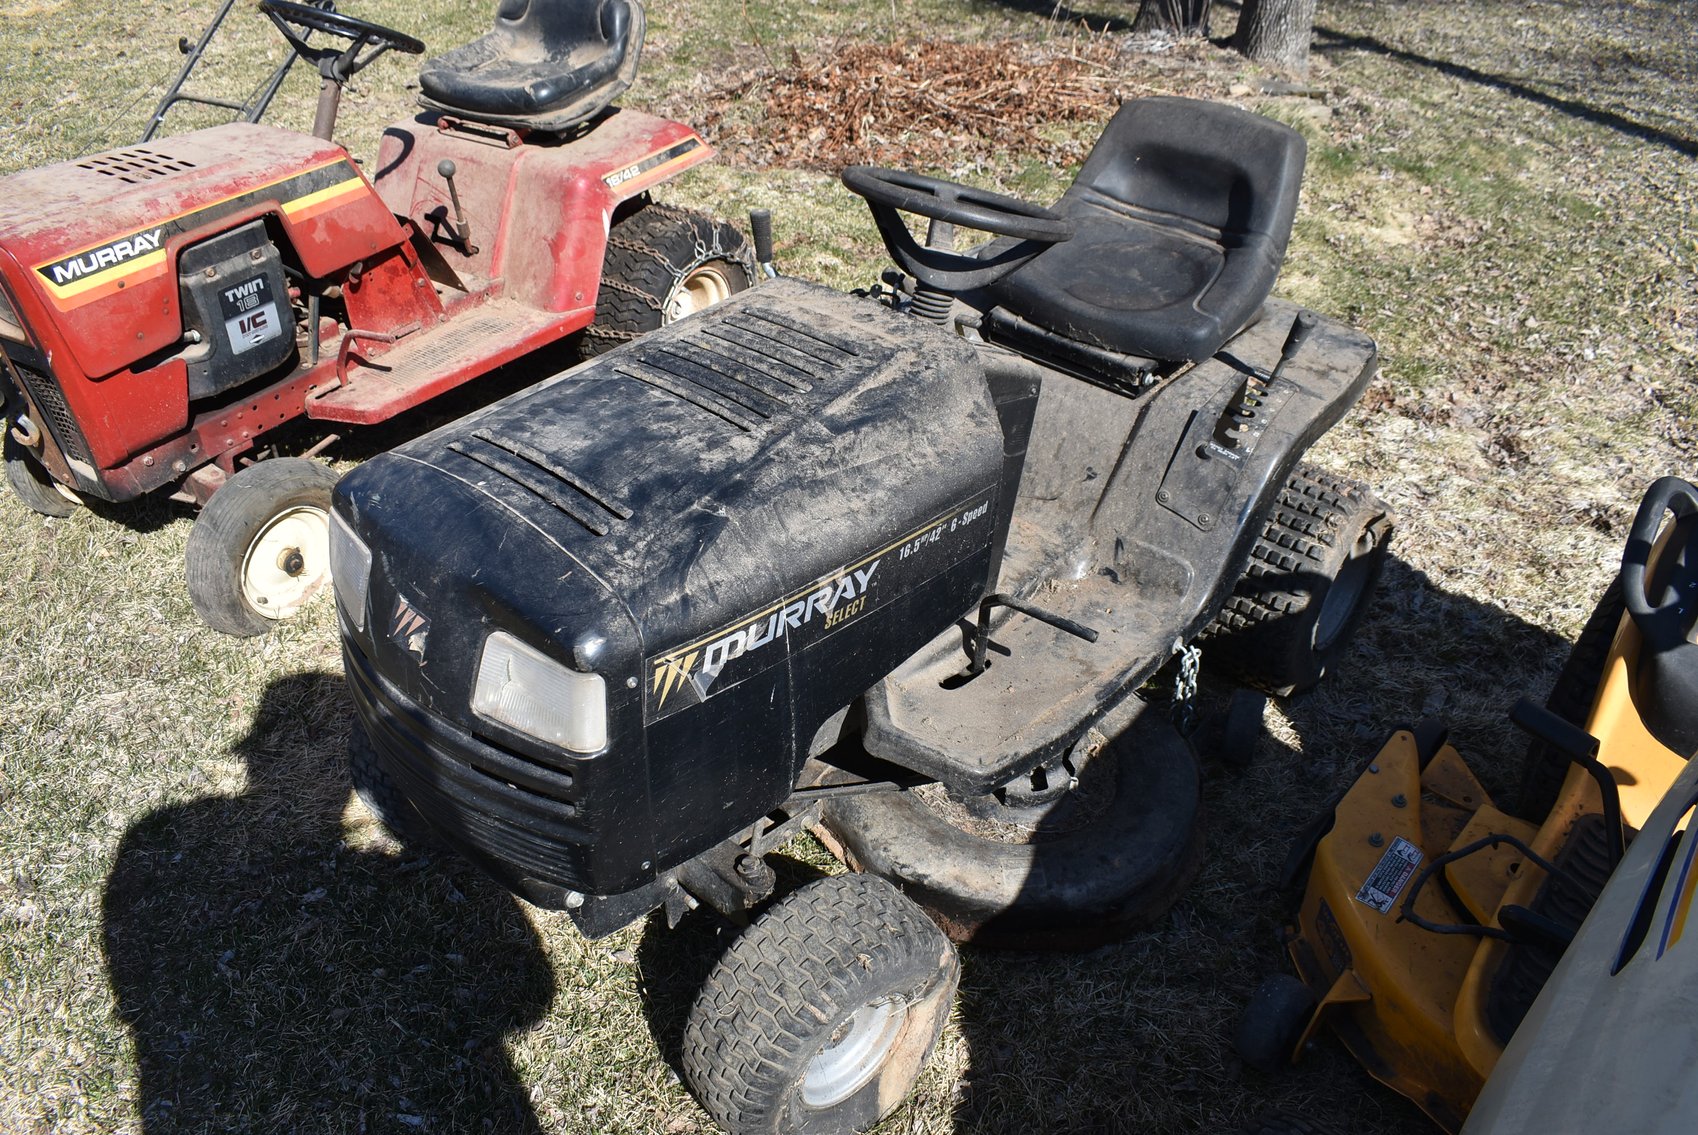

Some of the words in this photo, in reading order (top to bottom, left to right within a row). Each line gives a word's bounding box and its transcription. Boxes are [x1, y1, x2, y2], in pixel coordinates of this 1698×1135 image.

[53, 229, 161, 283] MURRAY
[225, 278, 264, 302] TWIN
[236, 293, 260, 312] 18
[702, 559, 881, 674] MURRAY
[823, 595, 867, 630] SELECT
